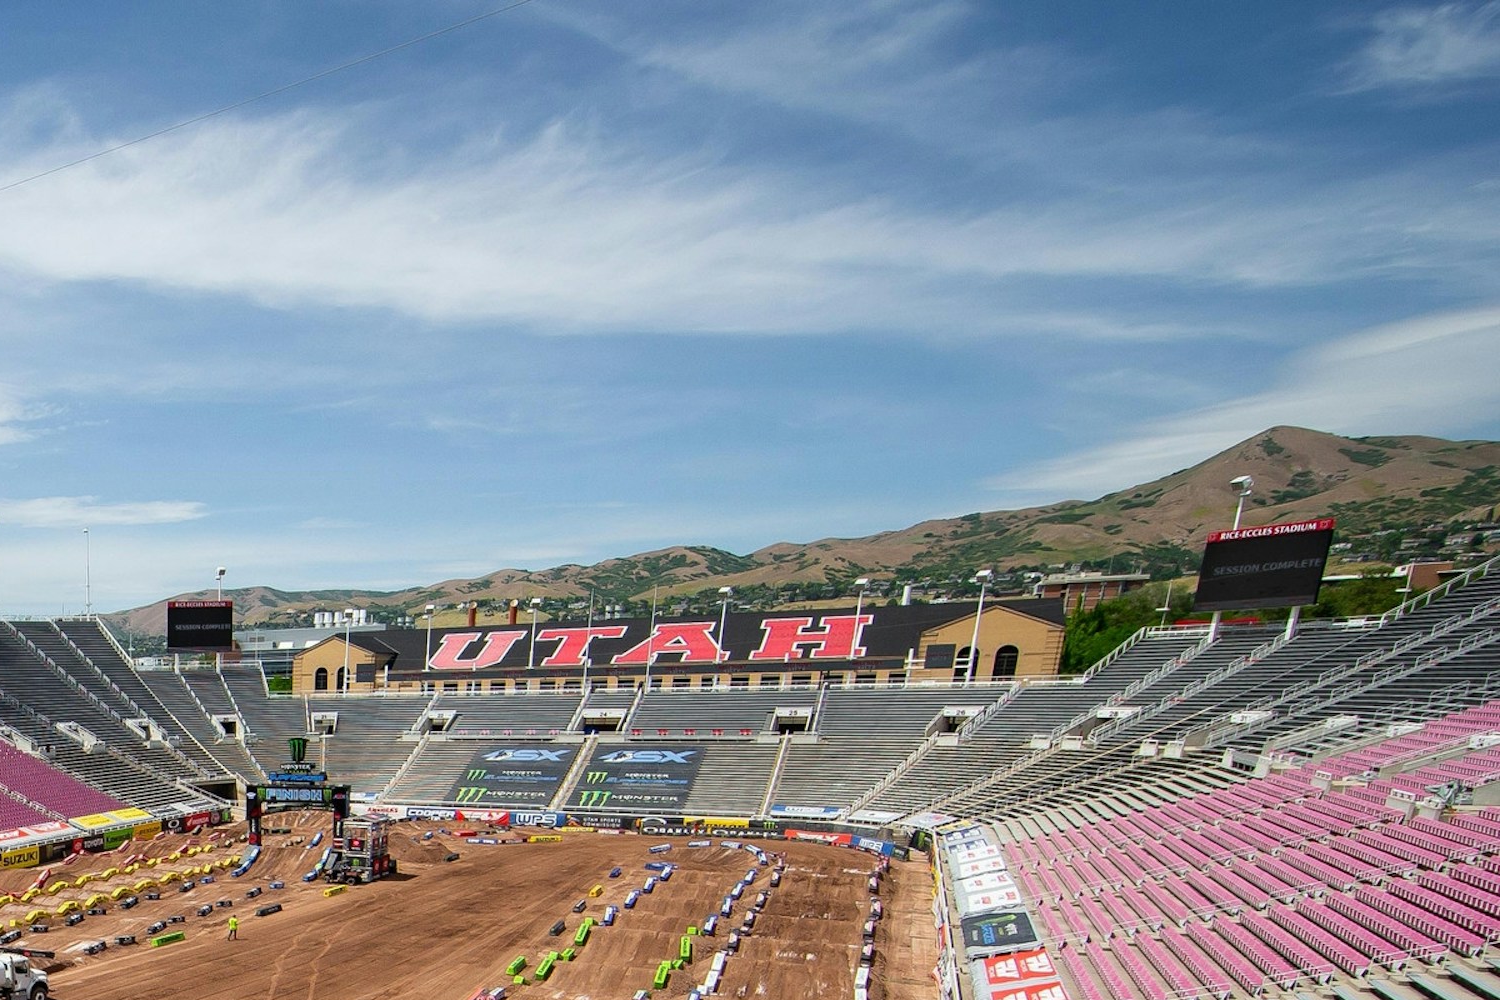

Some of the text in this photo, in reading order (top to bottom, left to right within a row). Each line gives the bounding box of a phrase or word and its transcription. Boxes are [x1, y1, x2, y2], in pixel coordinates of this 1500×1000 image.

[1219, 522, 1317, 541] RICE-ECCLES STADIUM
[1213, 557, 1323, 576] SESSION COMPLETE
[428, 614, 874, 670] UTAH
[265, 788, 322, 801] FINISH
[486, 790, 546, 798] MONSTER
[611, 794, 679, 802] MONSTER
[408, 808, 456, 817] COOPER
[516, 813, 557, 826] WPS
[3, 851, 38, 867] SUZUKI
